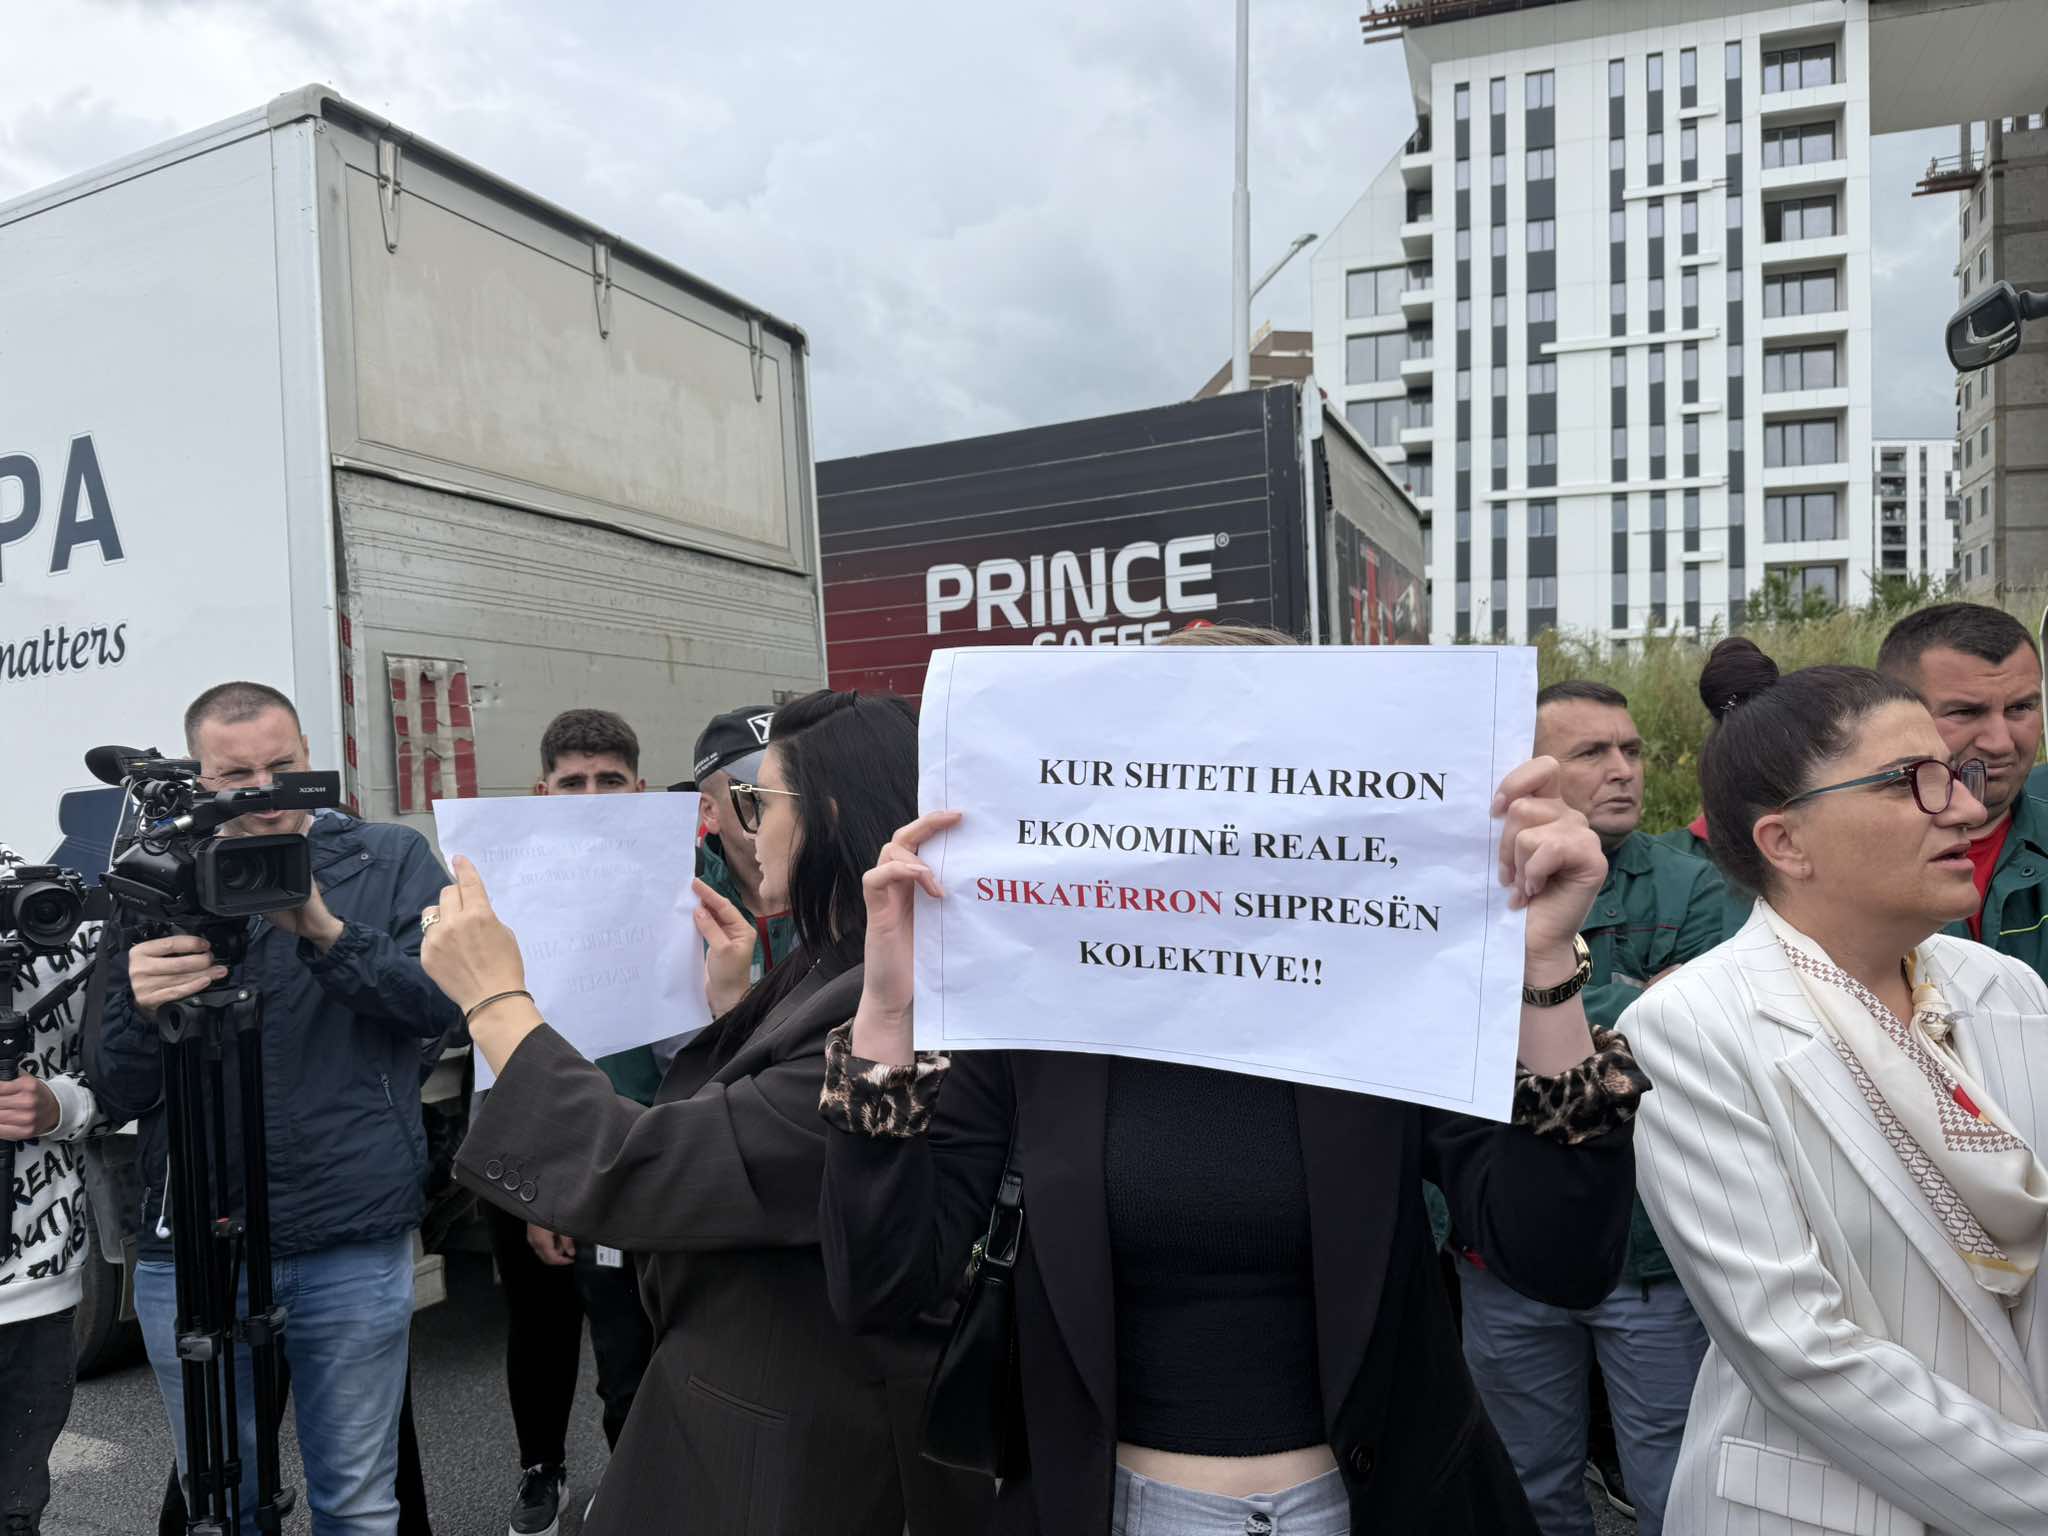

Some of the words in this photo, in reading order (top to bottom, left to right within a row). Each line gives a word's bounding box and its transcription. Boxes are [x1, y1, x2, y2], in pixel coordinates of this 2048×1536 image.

[926, 534, 1217, 634] PRINCE
[1039, 759, 1115, 787] KUR
[1125, 761, 1257, 793] SHTETI
[1269, 767, 1447, 801] HARRON
[1018, 819, 1240, 857] EKONOMINË
[1253, 832, 1398, 869] REALE,
[976, 877, 1222, 915] SHKATËRRON
[1234, 892, 1440, 932] SHPRESËN
[1079, 940, 1322, 986] KOLEKTIVE!!
